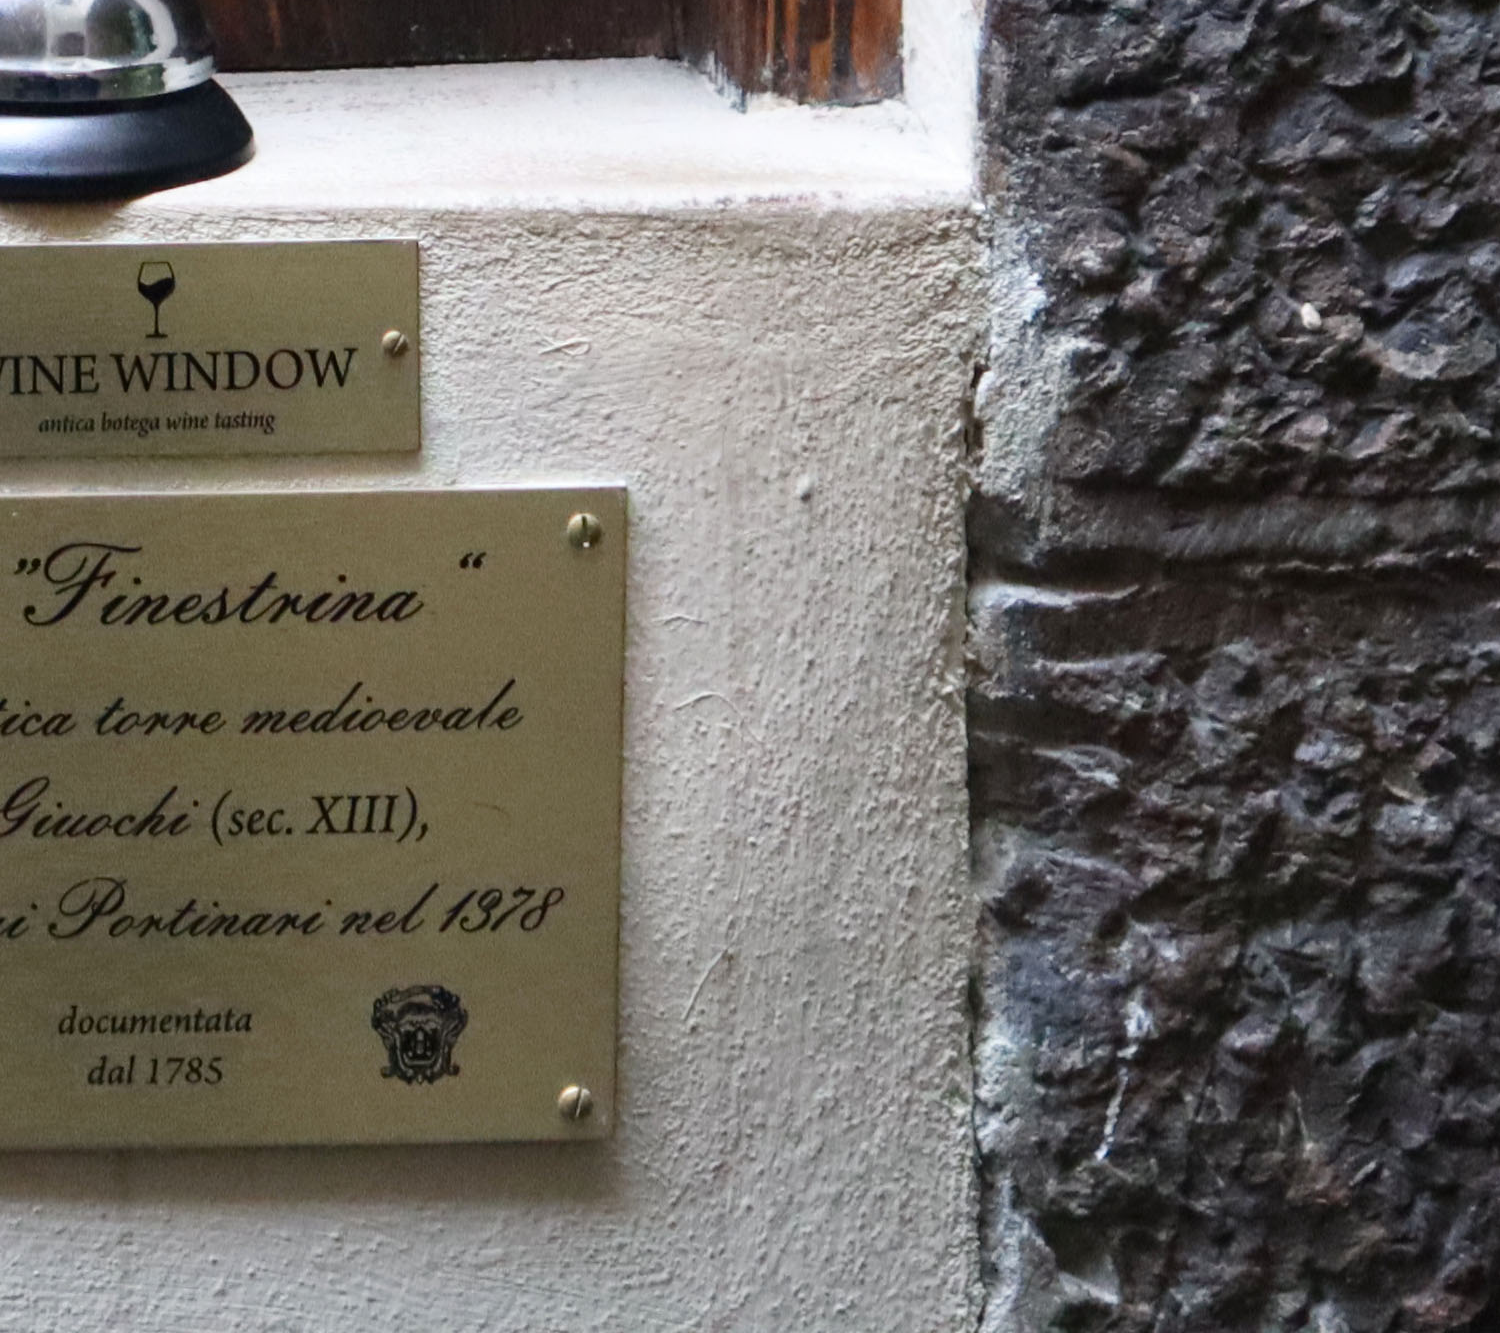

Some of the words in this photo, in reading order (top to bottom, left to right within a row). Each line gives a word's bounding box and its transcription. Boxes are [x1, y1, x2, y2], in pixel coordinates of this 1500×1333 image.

[110, 347, 358, 393] WINDOW
[38, 413, 96, 434] antica
[166, 411, 210, 431] wine
[214, 410, 276, 435] tasting
[94, 695, 227, 736] torre
[240, 677, 525, 735] medioevale
[210, 789, 294, 846] (sec.
[305, 786, 430, 844] XIII),
[47, 876, 334, 940] Portinari
[339, 882, 440, 936] nel
[438, 885, 566, 934] 1378
[57, 1005, 253, 1036] documentata
[86, 1055, 137, 1086] dal
[147, 1055, 225, 1086] 1785
